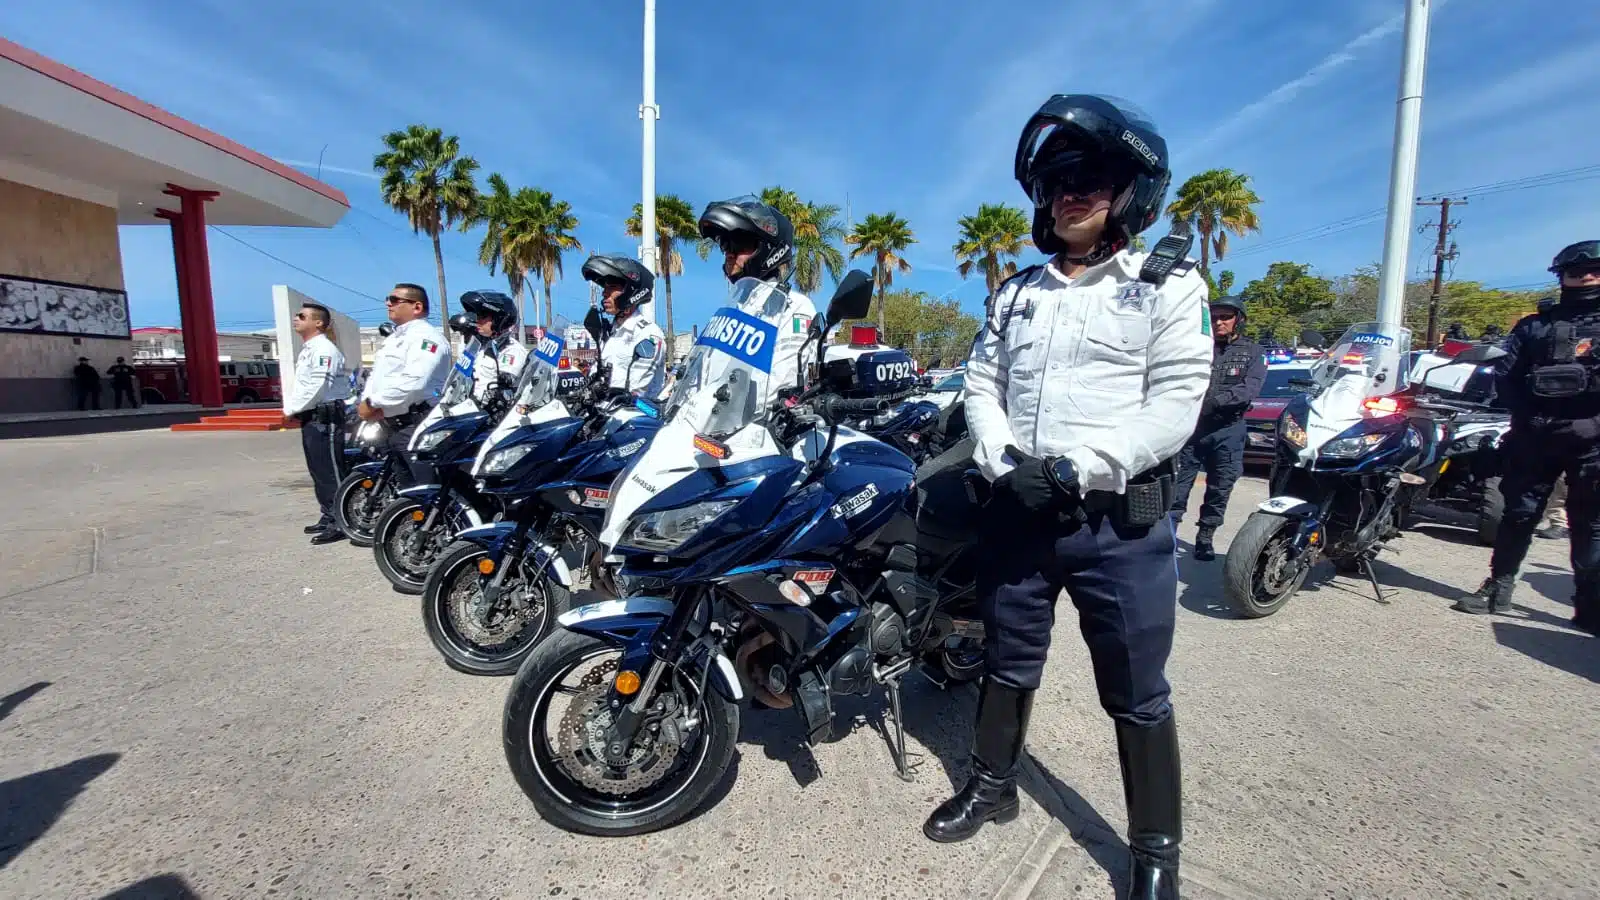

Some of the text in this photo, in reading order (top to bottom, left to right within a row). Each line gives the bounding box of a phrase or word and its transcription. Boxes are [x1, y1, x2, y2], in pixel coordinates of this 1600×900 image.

[1122, 130, 1158, 165] RODA
[767, 244, 790, 268] RODA
[631, 288, 649, 304] RODA
[876, 361, 910, 382] 0792
[831, 484, 879, 517] Kawasaki
